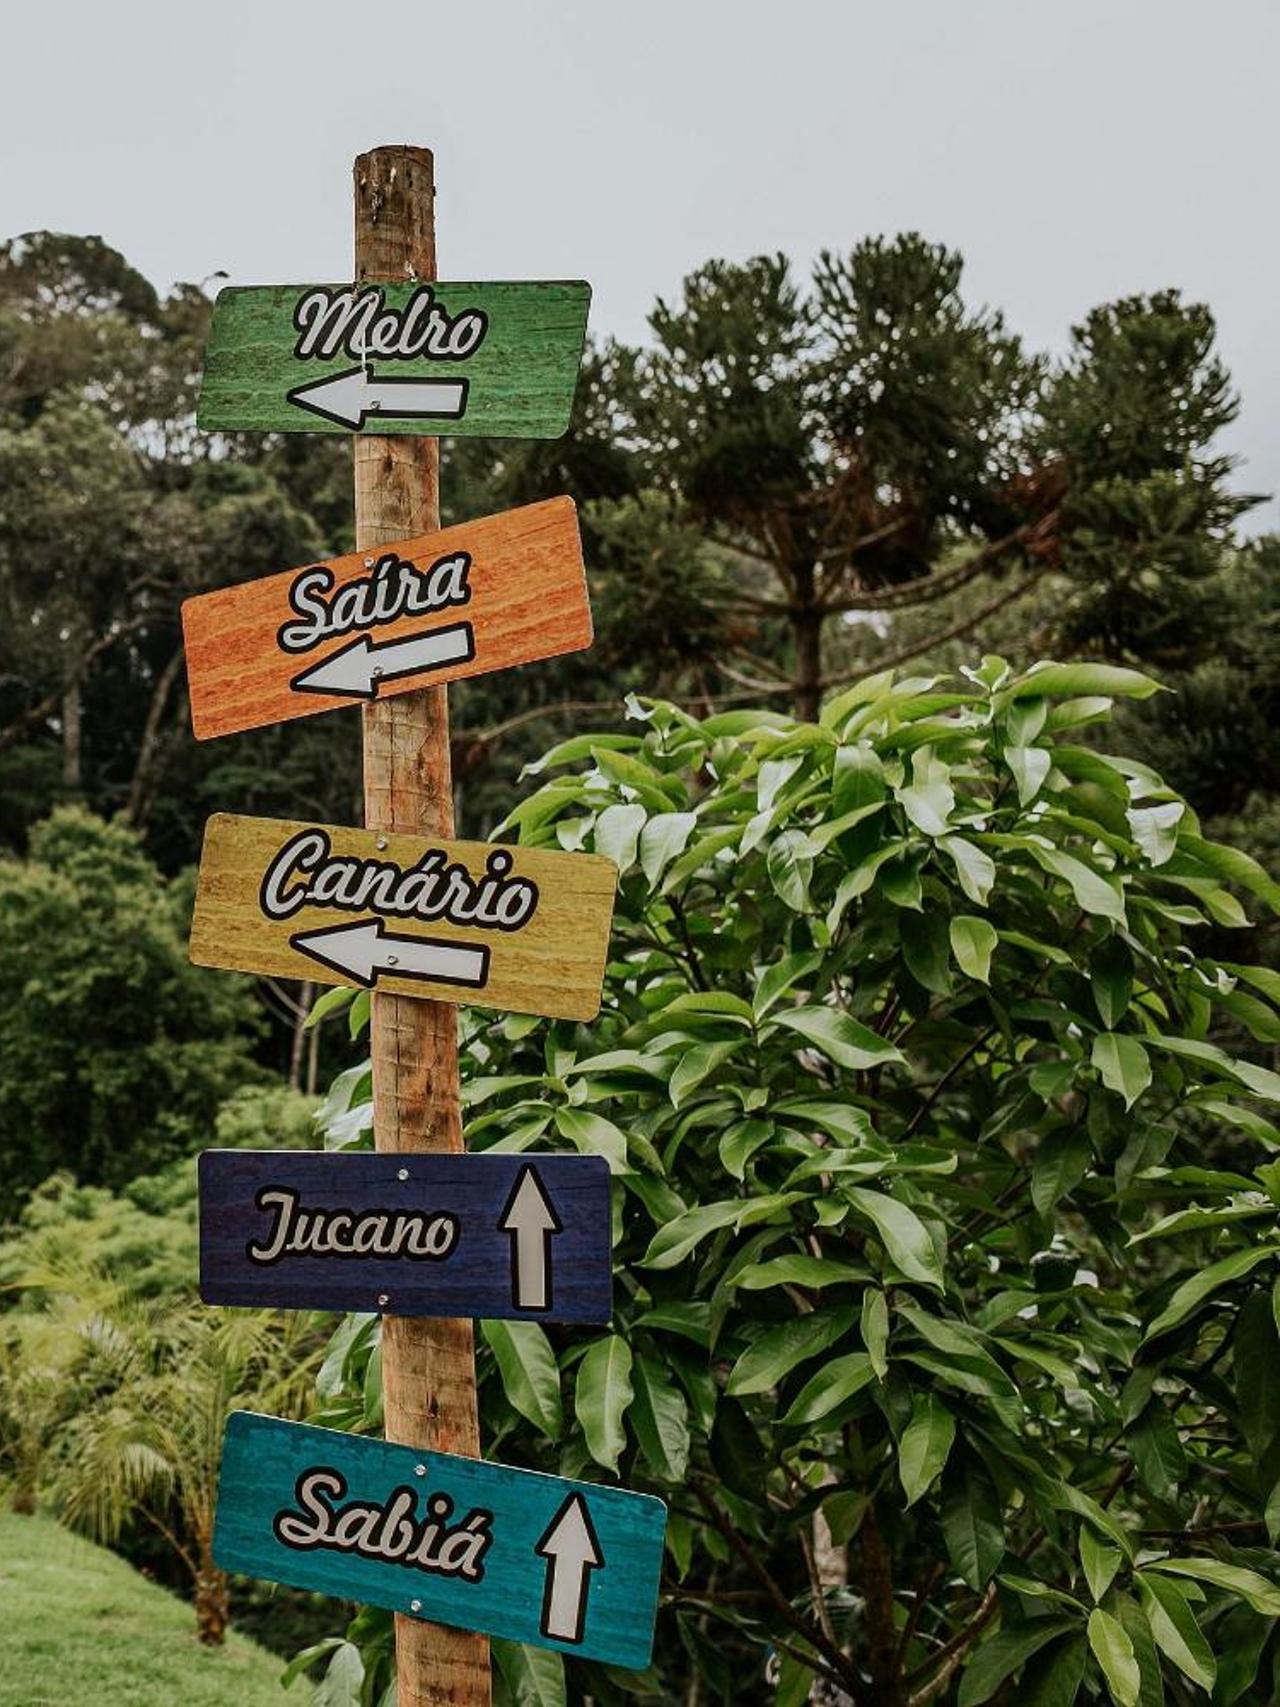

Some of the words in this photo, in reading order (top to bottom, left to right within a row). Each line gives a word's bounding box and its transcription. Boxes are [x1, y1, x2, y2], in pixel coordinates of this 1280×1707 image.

[296, 287, 486, 358] Melro
[280, 555, 470, 650] Saíra
[263, 831, 536, 929] Canário
[276, 1470, 492, 1580] Sabiá
